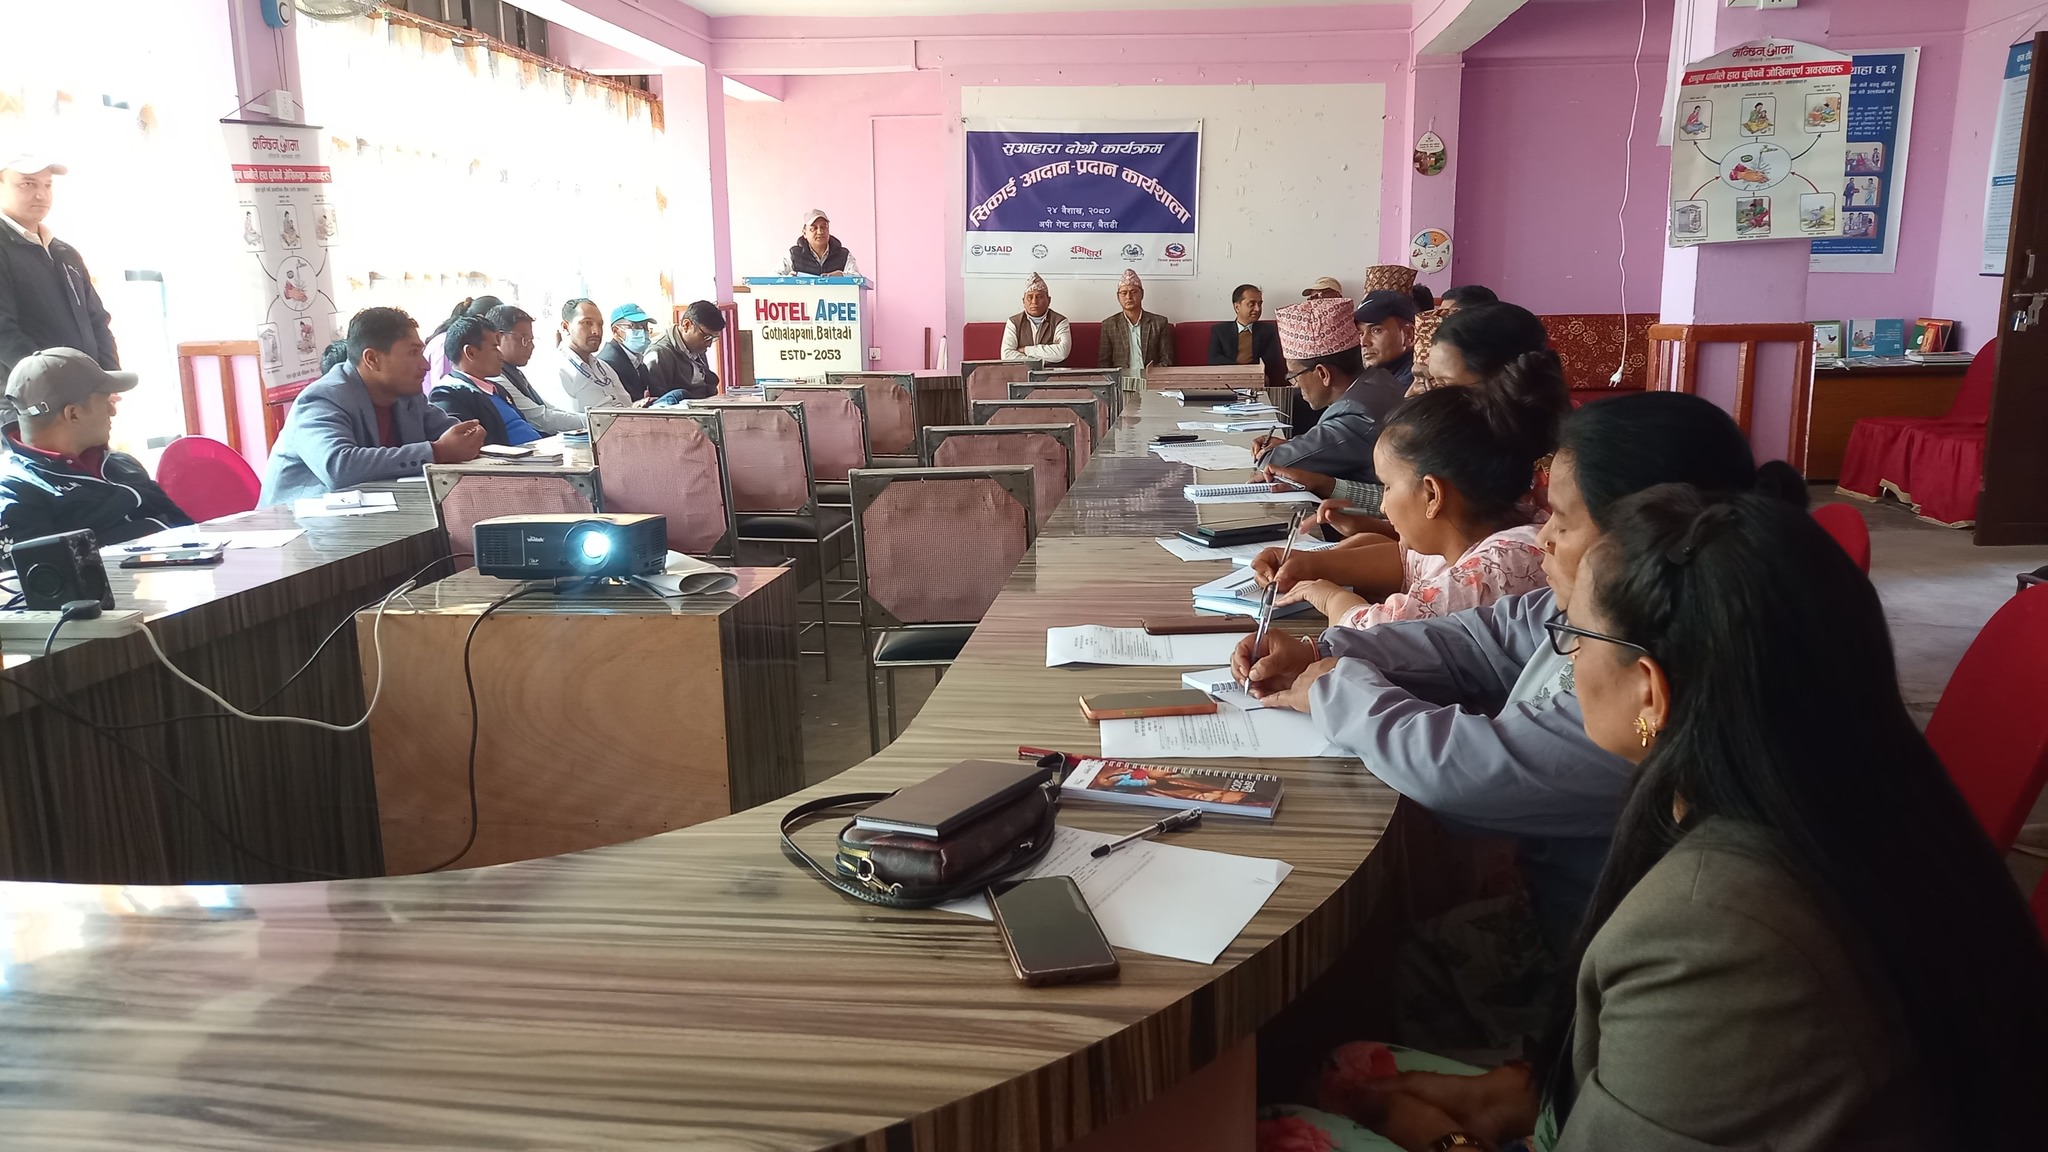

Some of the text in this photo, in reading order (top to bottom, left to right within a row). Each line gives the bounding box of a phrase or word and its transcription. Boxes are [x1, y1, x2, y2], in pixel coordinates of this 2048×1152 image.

[1732, 45, 1767, 57] भन्छिन्
[1726, 71, 1740, 80] हात
[1766, 65, 1804, 78] जोखिमपूर्ण
[1875, 65, 1888, 75] छ
[1891, 65, 1897, 74] ?
[1002, 142, 1061, 156] सुआहारा
[1100, 141, 1166, 155] कार्यक्रम
[968, 159, 1192, 229] सिकाई आदान-प्रदान कार्यशाला
[1046, 206, 1059, 215] २४
[1088, 207, 1111, 215] २०८०
[1073, 221, 1095, 230] हाउस,
[985, 245, 1013, 253] USAID
[755, 299, 857, 322] HOTEL APEE
[780, 349, 842, 361] ESTD-2053
